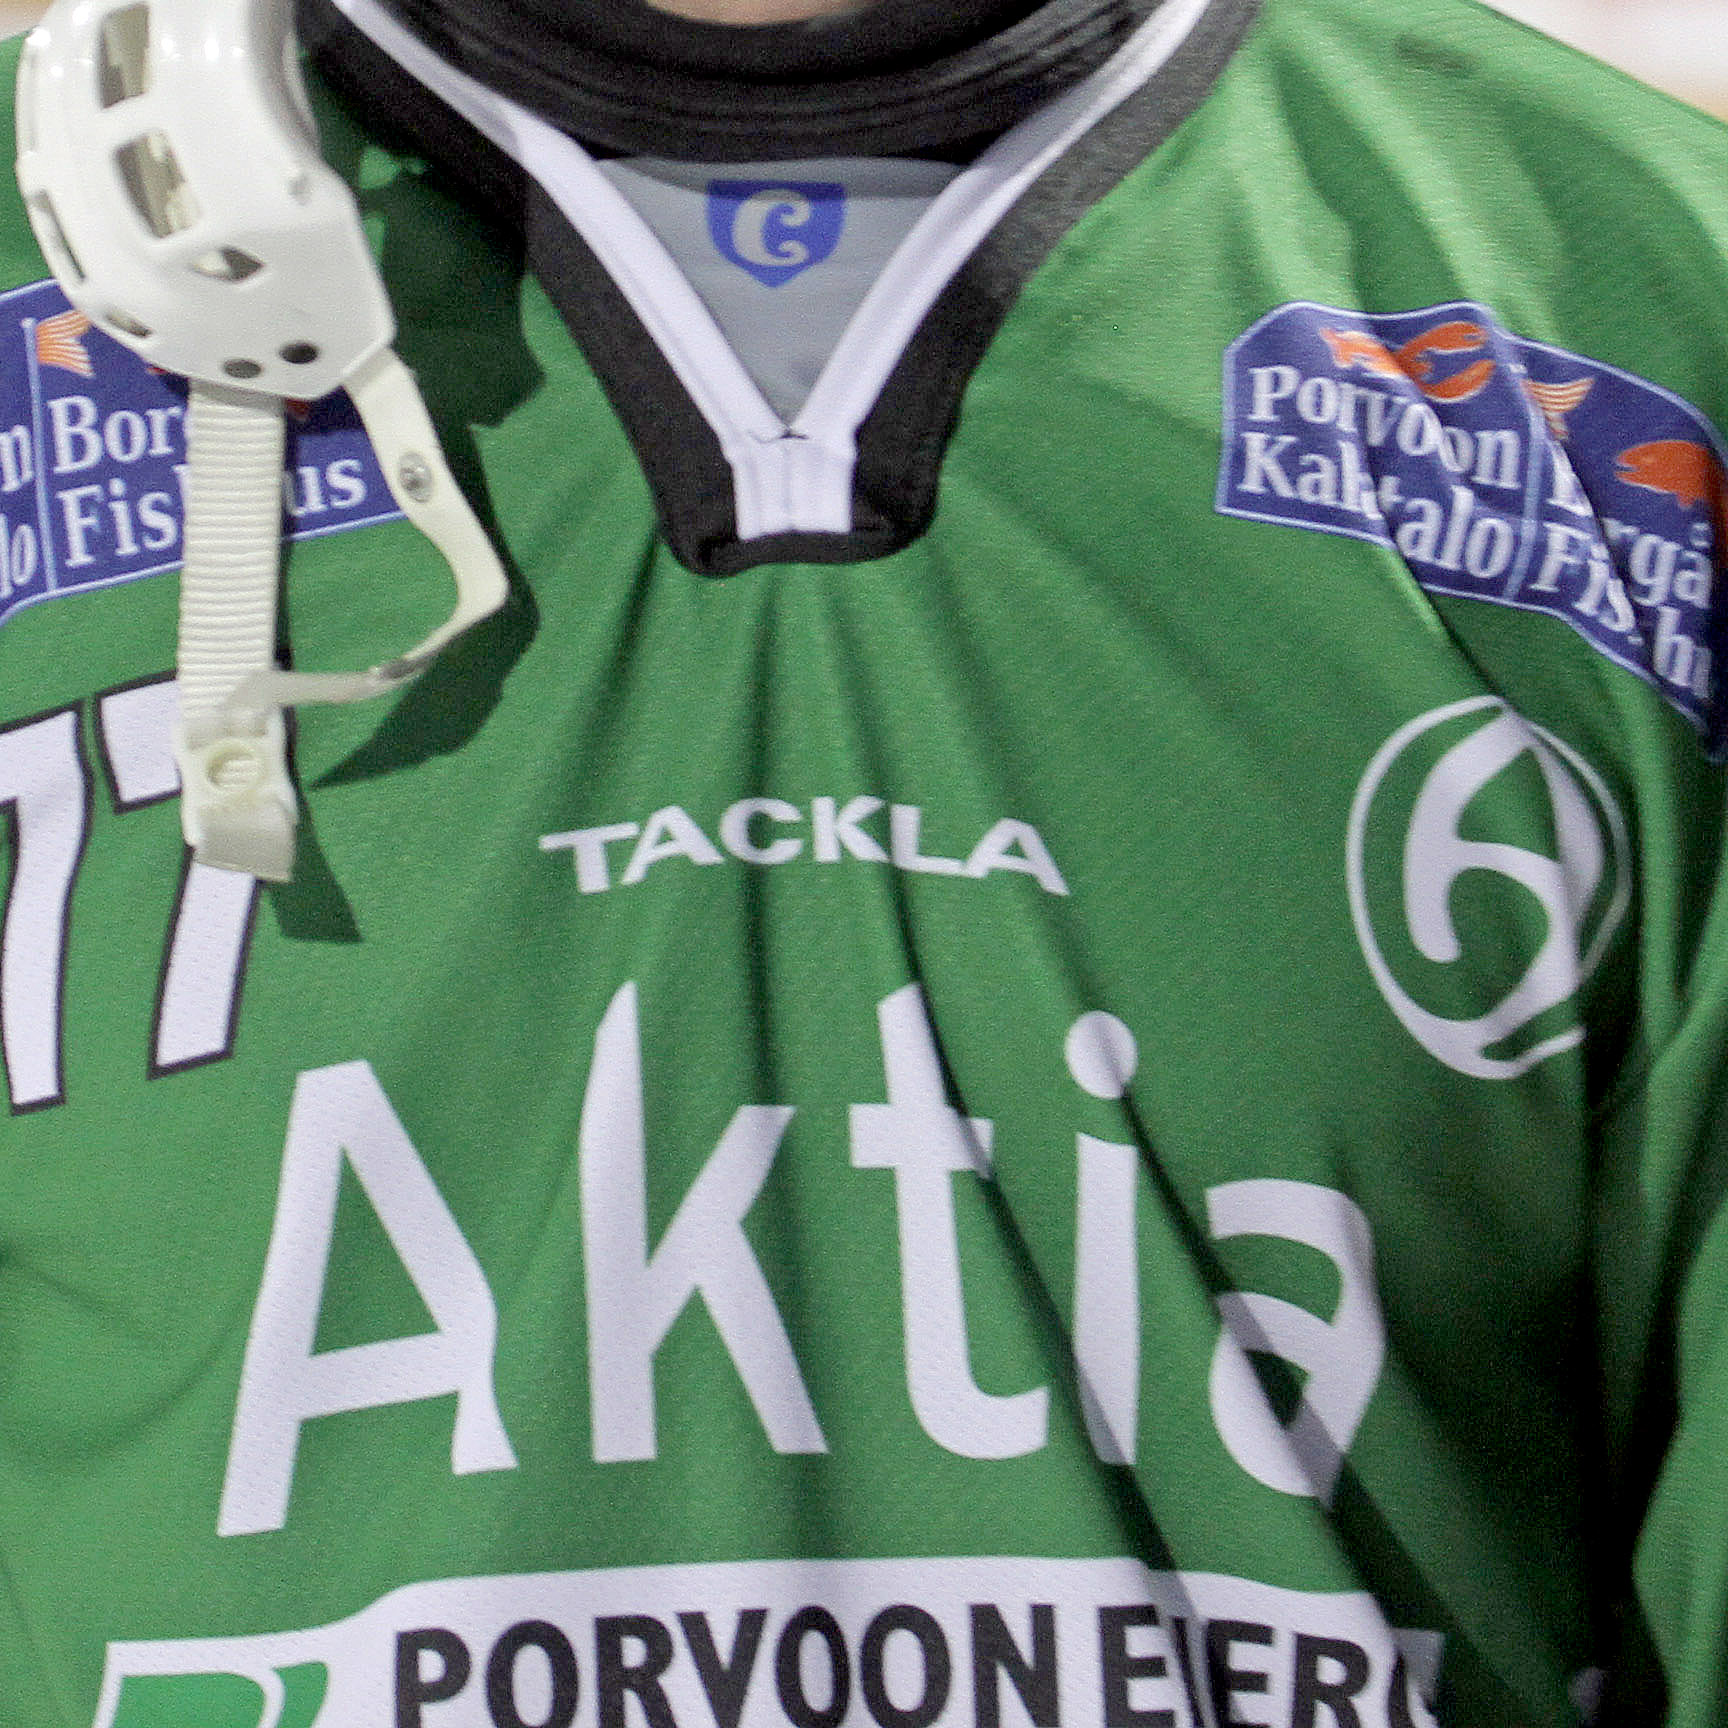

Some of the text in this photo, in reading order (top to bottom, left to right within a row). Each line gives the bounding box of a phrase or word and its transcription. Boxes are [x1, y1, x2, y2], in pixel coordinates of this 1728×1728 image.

[47, 395, 186, 477] Bor
[1247, 365, 1521, 490] Porvoon
[537, 795, 1071, 896] TACKLA
[217, 980, 1387, 1538] Aktia
[392, 1603, 1061, 1728] PORVOON
